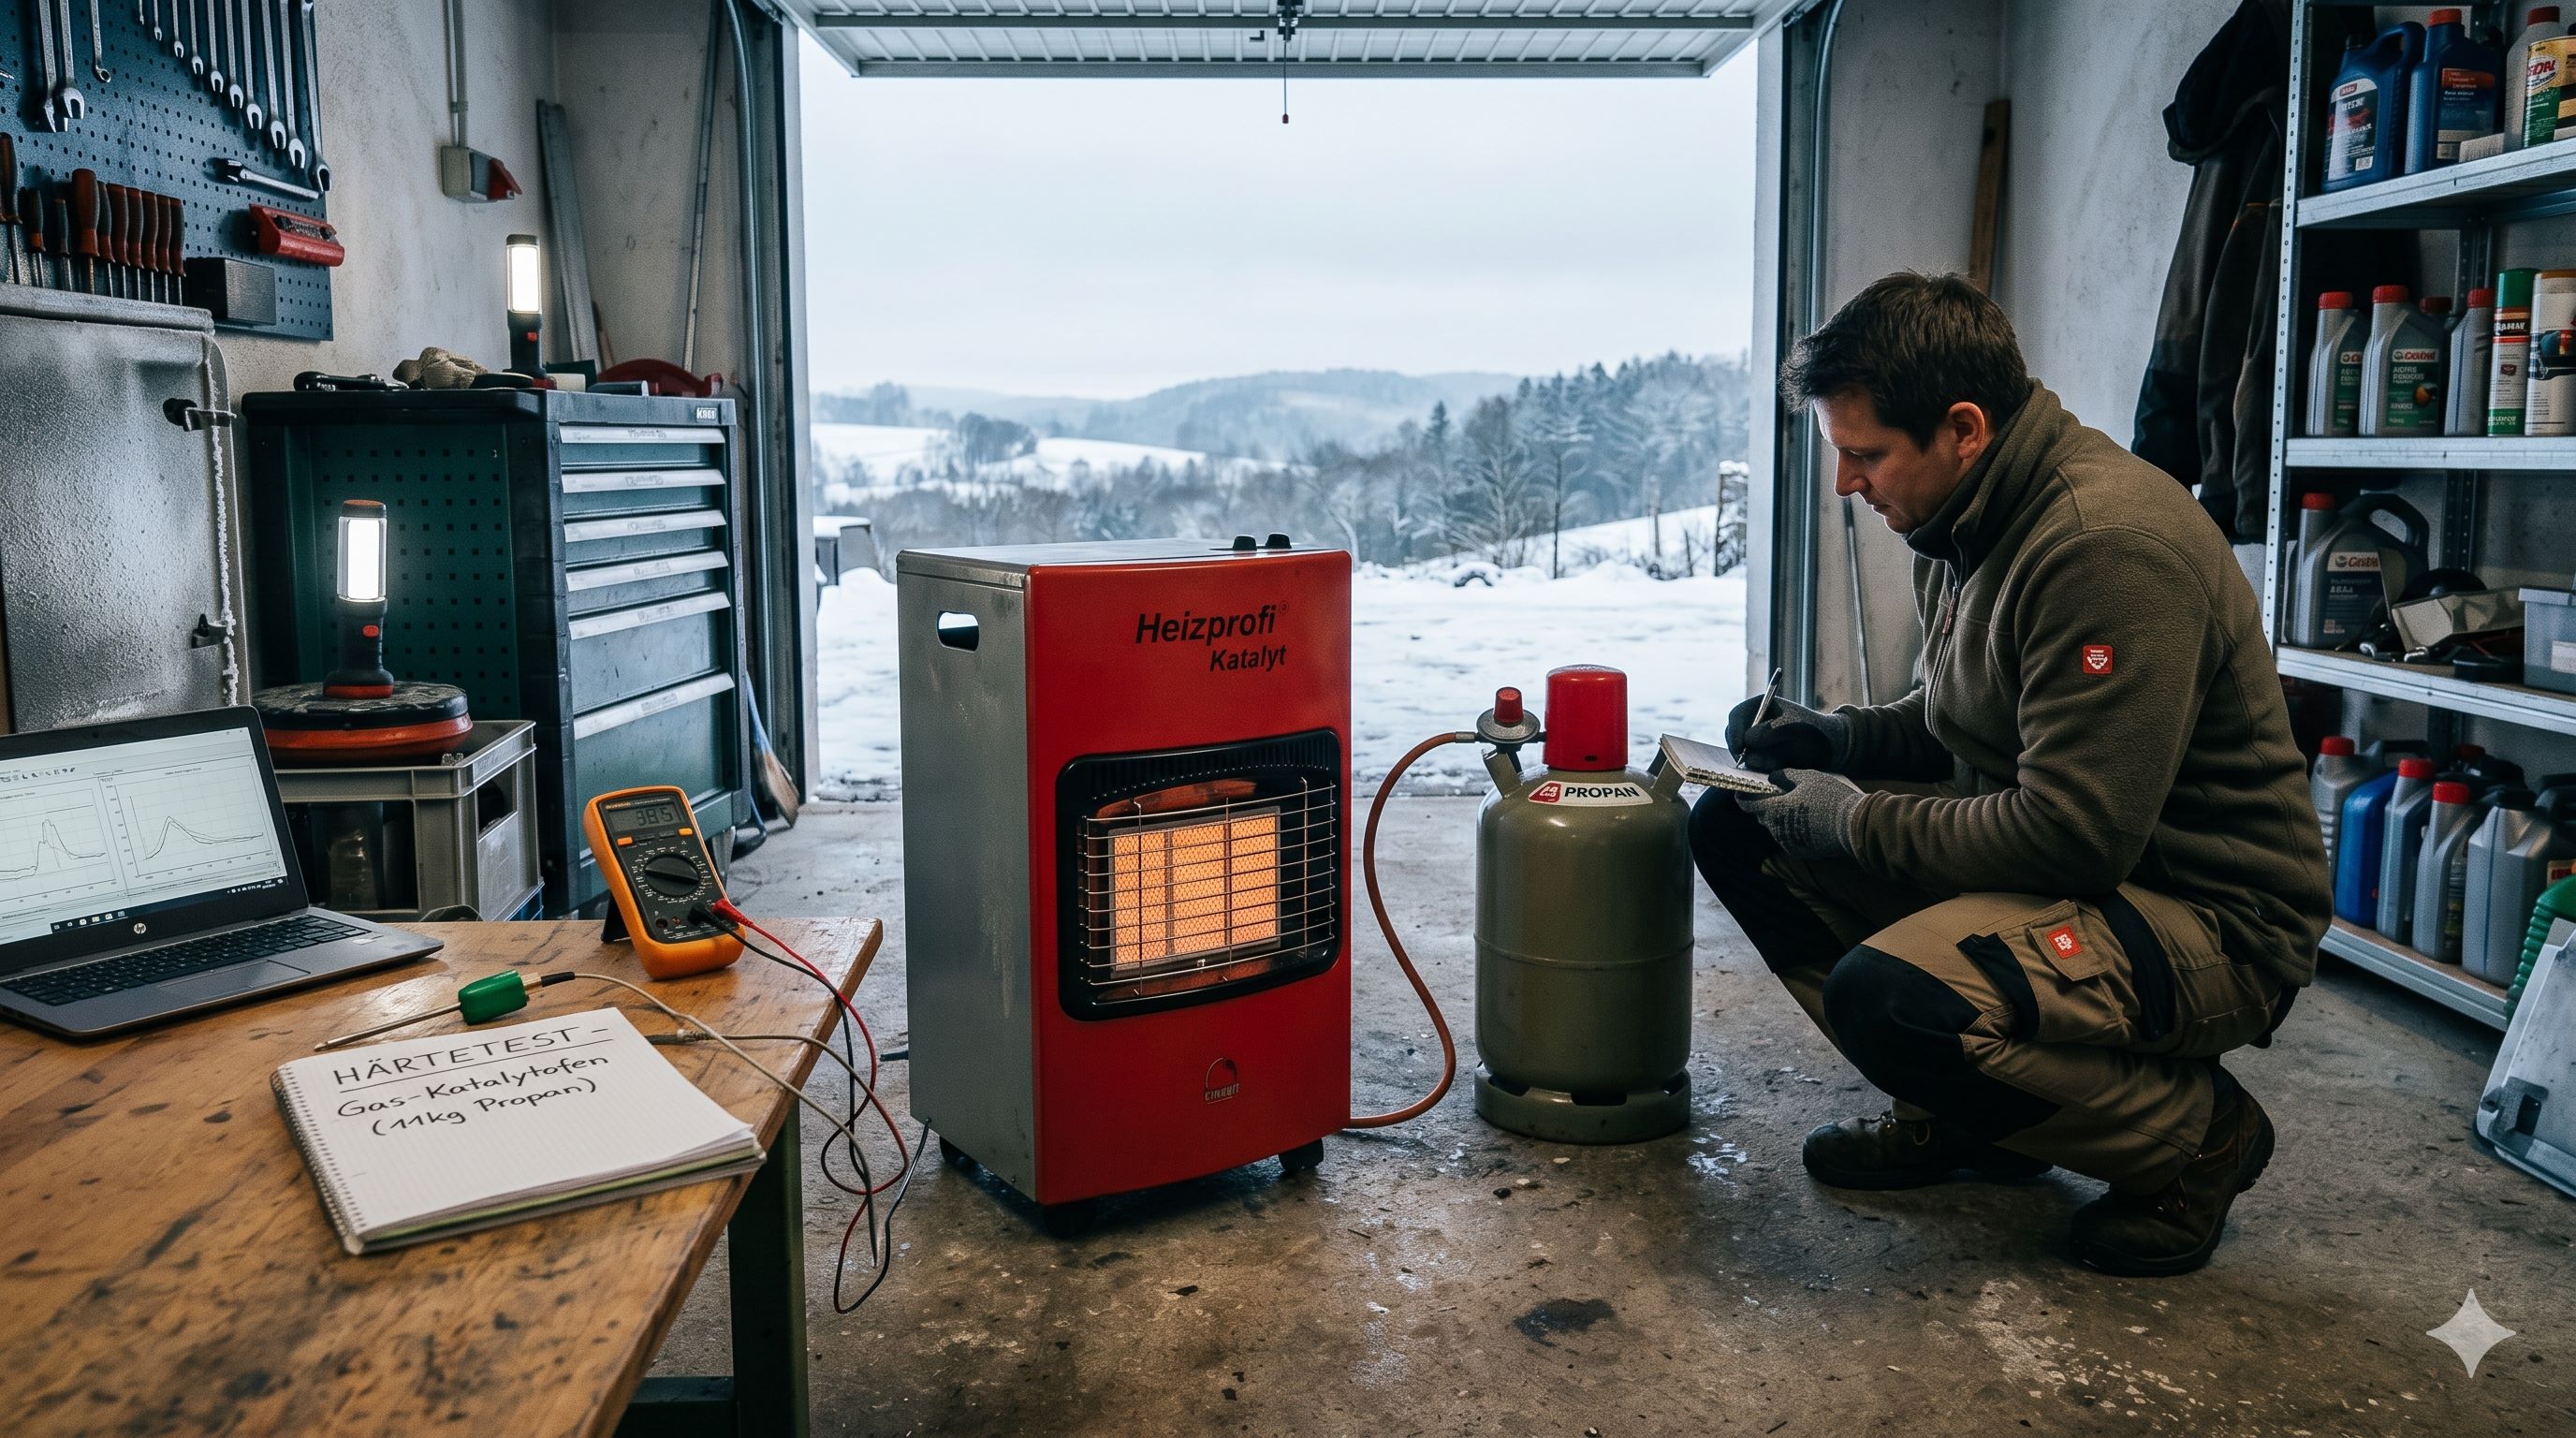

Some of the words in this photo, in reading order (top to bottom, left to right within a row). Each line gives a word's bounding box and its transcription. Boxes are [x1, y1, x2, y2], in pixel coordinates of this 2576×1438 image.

[1135, 605, 1277, 647] Heizprofi
[1209, 645, 1286, 673] Katalyt
[1564, 786, 1640, 799] PROPAN
[333, 1026, 580, 1085] HÄRTETEST
[337, 1057, 609, 1117] Gas-Katalytofen
[372, 1111, 466, 1137] (11kg
[473, 1077, 596, 1112] Propan)
